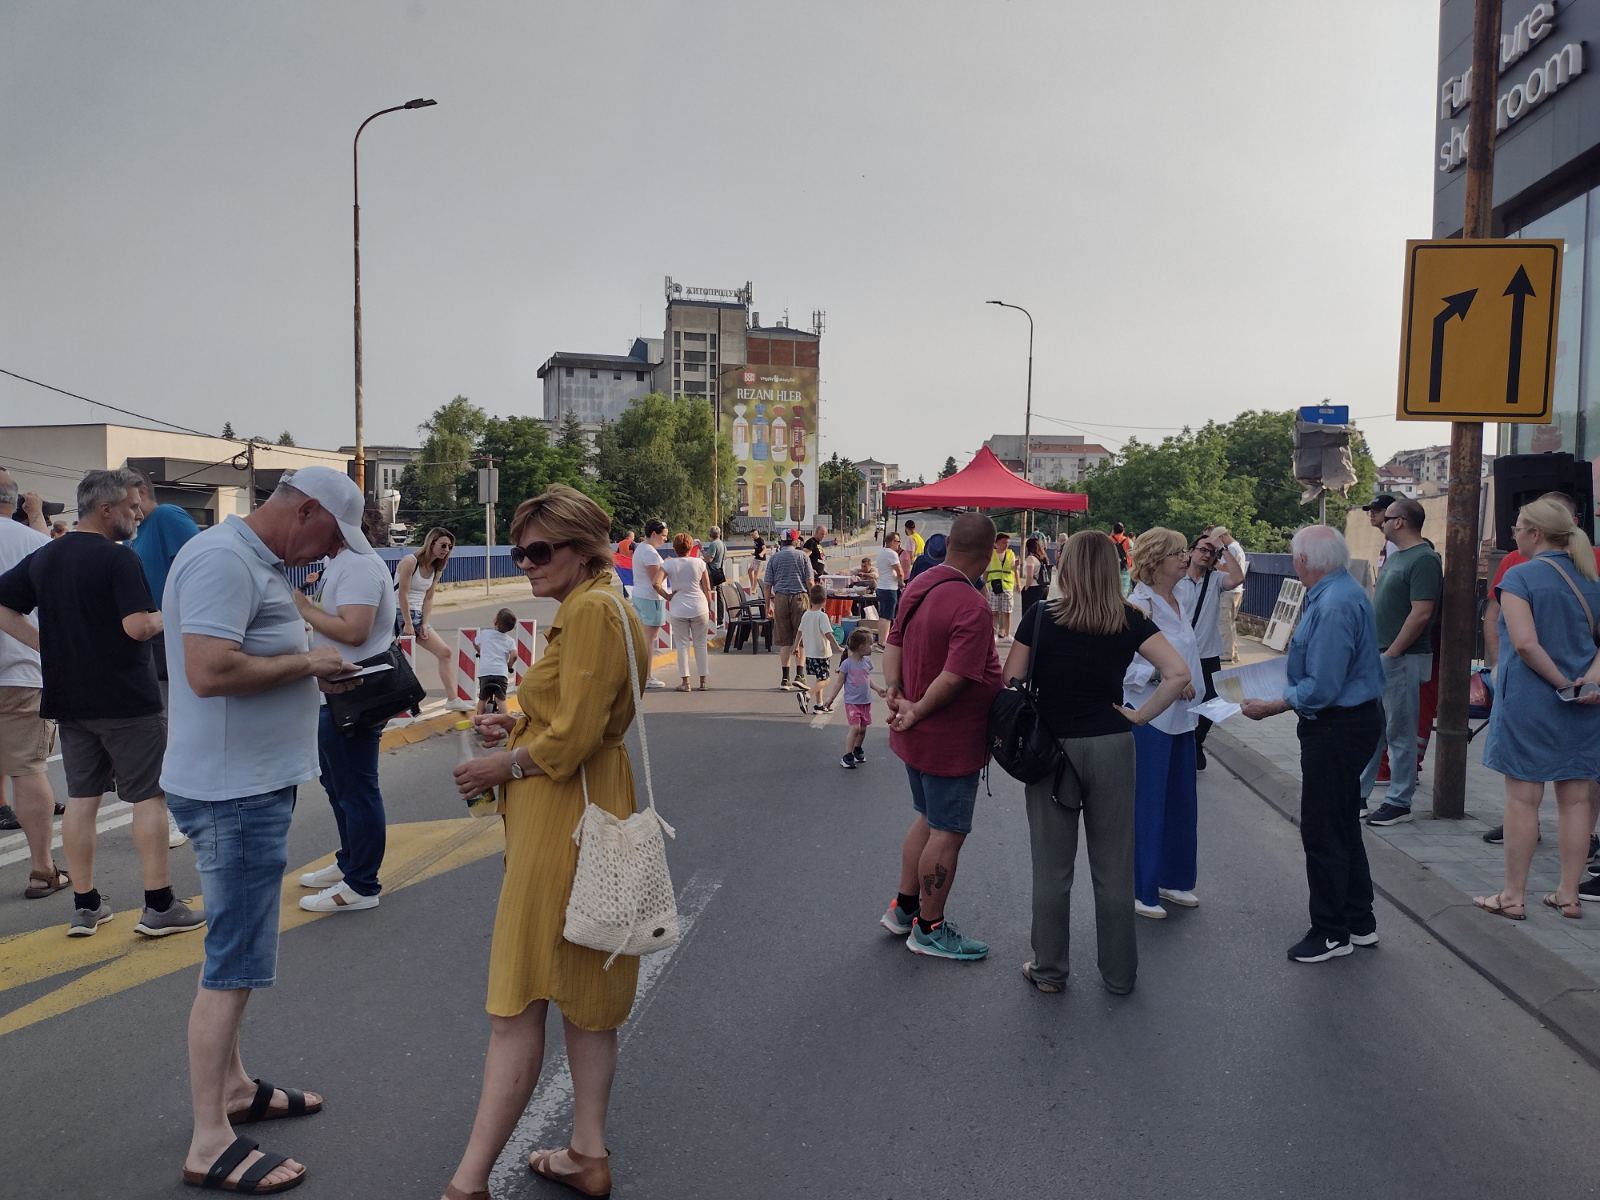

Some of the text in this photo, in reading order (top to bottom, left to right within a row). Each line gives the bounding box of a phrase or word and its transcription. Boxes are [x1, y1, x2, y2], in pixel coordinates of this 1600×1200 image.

[1441, 3, 1555, 121] Furure
[1439, 43, 1583, 172] shroom
[686, 286, 745, 299] ЖИТОПРОДУК
[737, 388, 802, 402] REZANI HLEB
